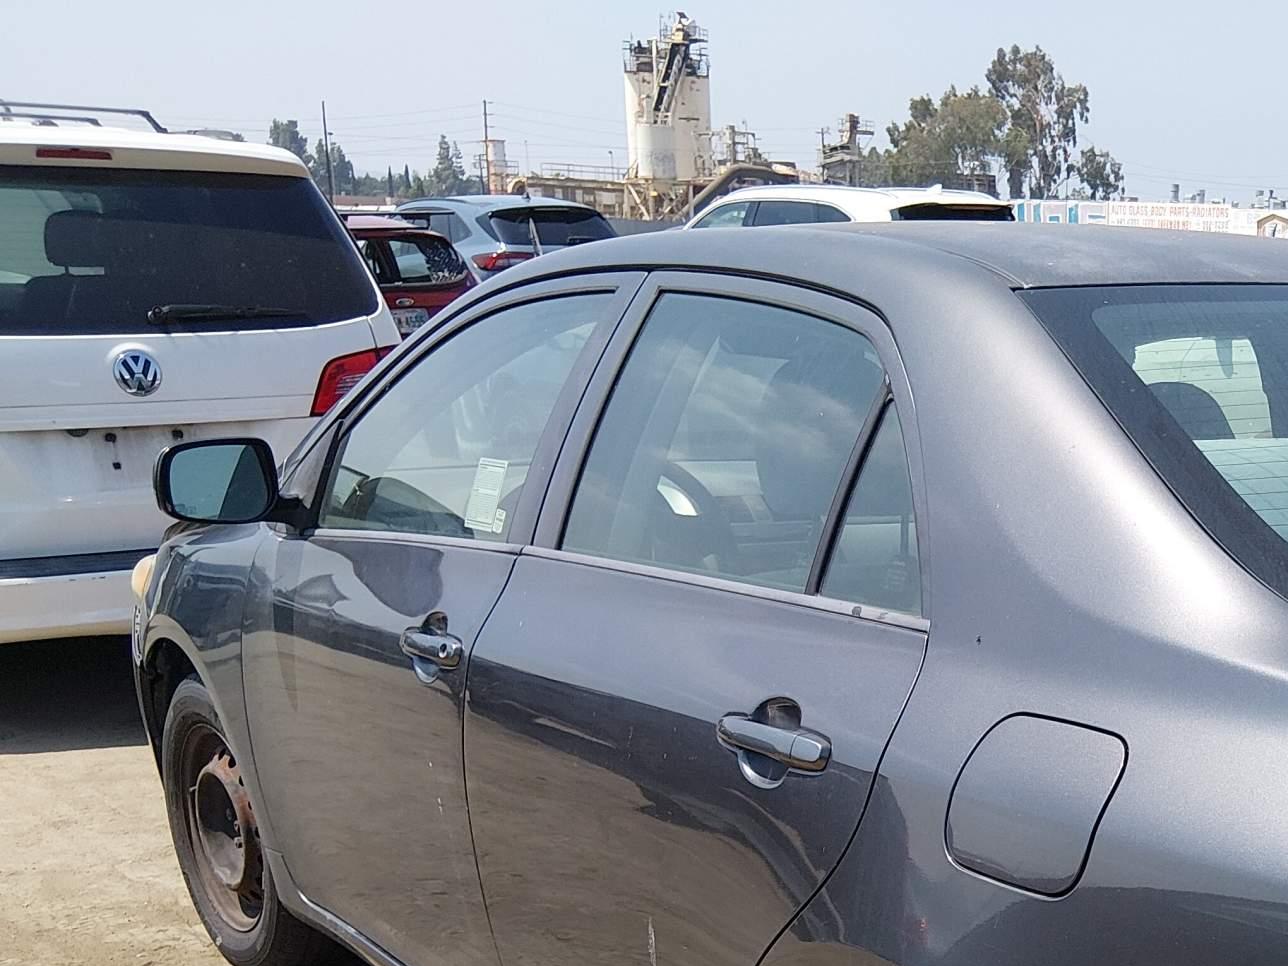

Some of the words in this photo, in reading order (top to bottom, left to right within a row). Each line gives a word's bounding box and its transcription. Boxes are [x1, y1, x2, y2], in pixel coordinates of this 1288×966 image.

[1111, 205, 1127, 215] AUTO
[1129, 205, 1149, 216] GLASS
[1151, 206, 1167, 217] BODY
